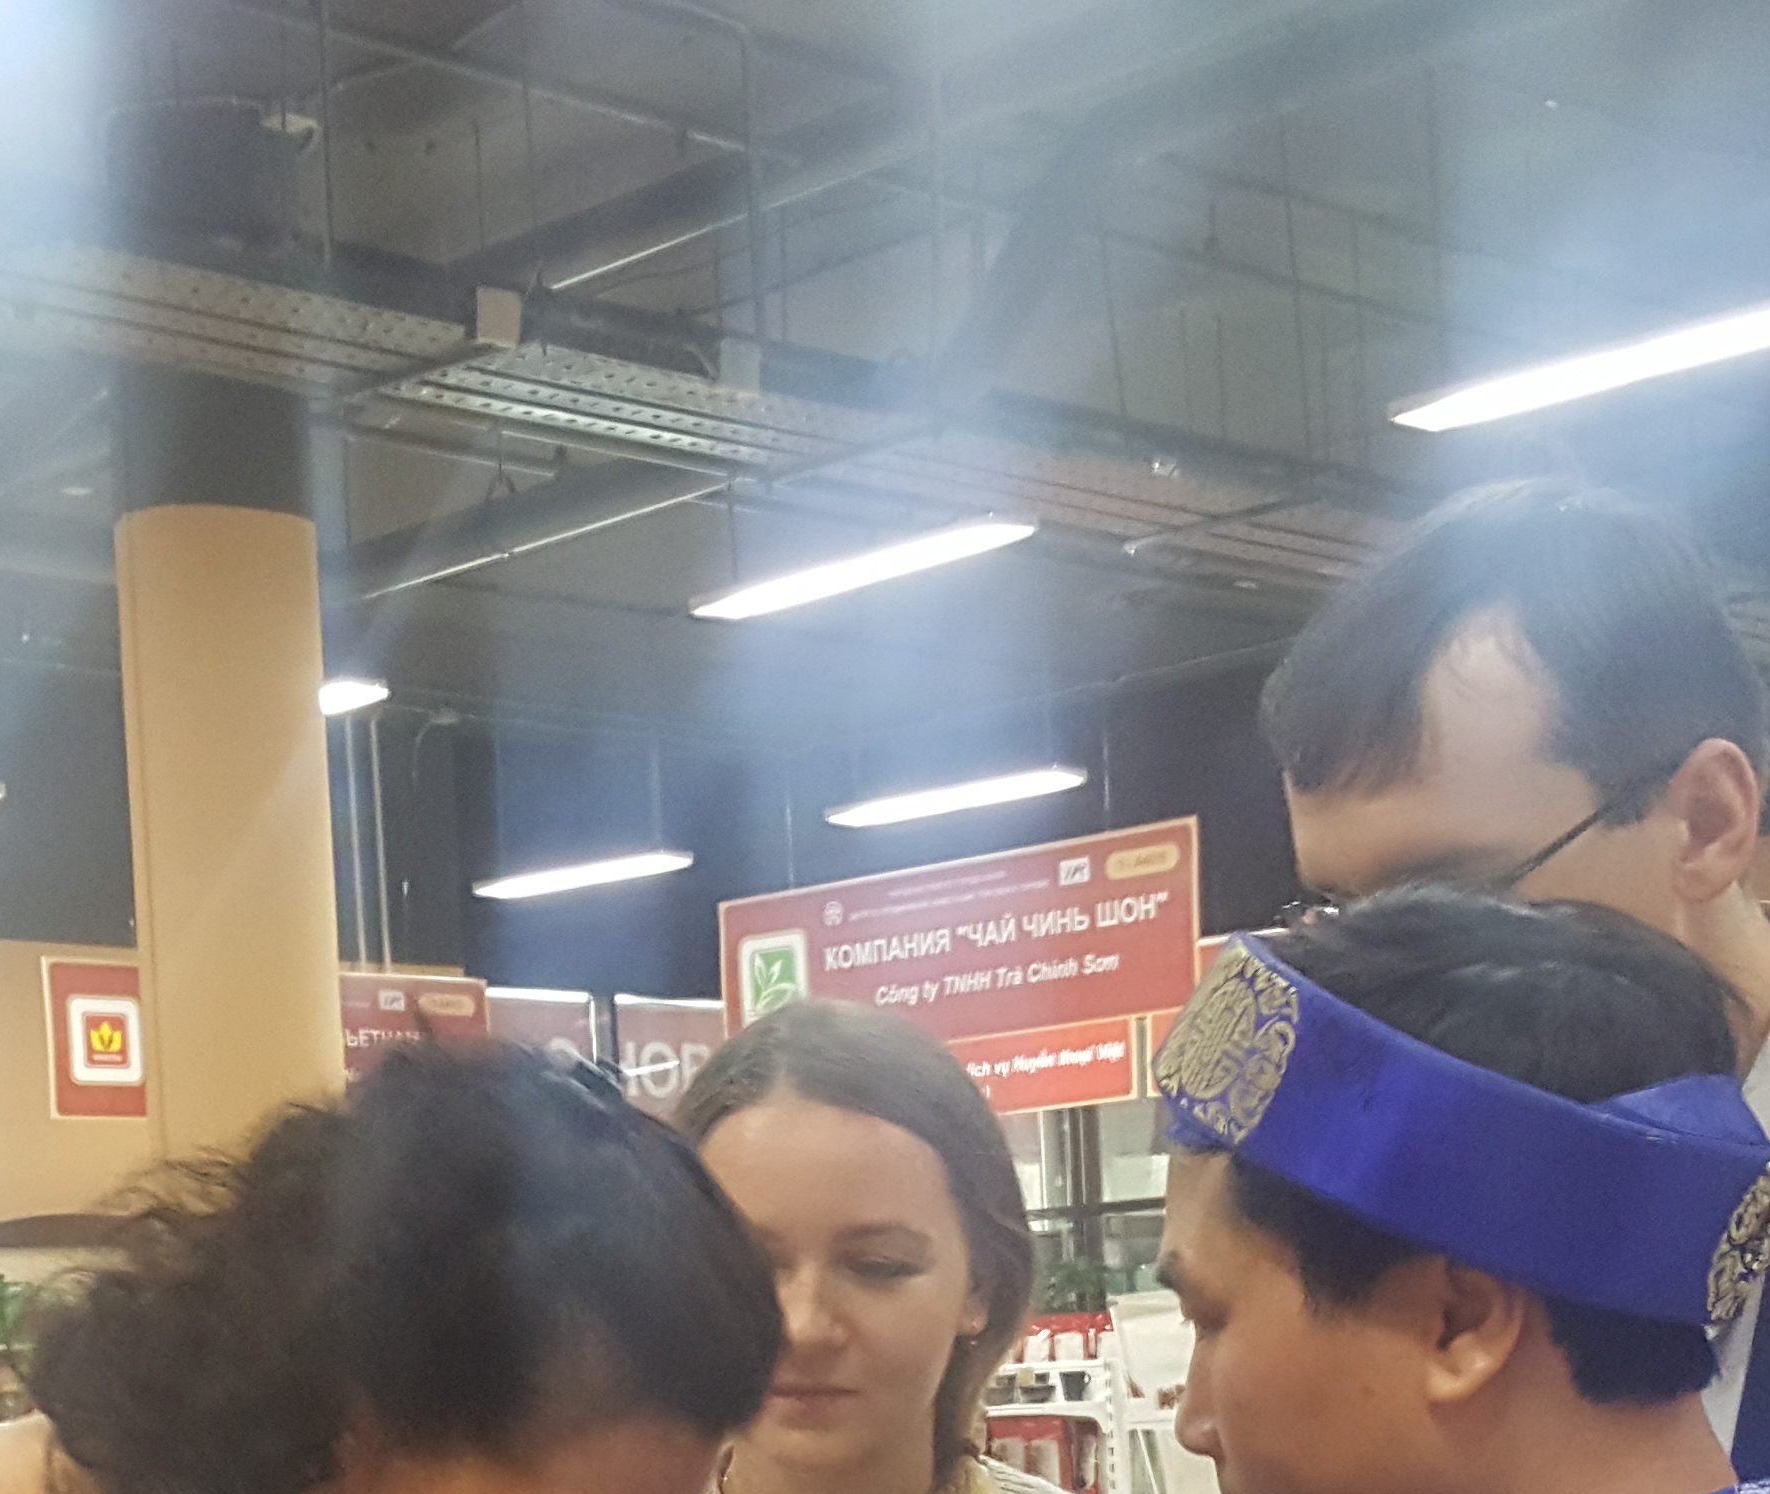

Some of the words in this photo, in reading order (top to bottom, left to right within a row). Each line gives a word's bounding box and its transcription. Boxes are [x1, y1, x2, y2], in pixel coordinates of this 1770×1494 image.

[824, 927, 951, 973] КОМПАНИЯ
[1023, 904, 1090, 939] ЧИНЬ
[875, 980, 919, 1008] Công
[943, 968, 991, 993] TNHH
